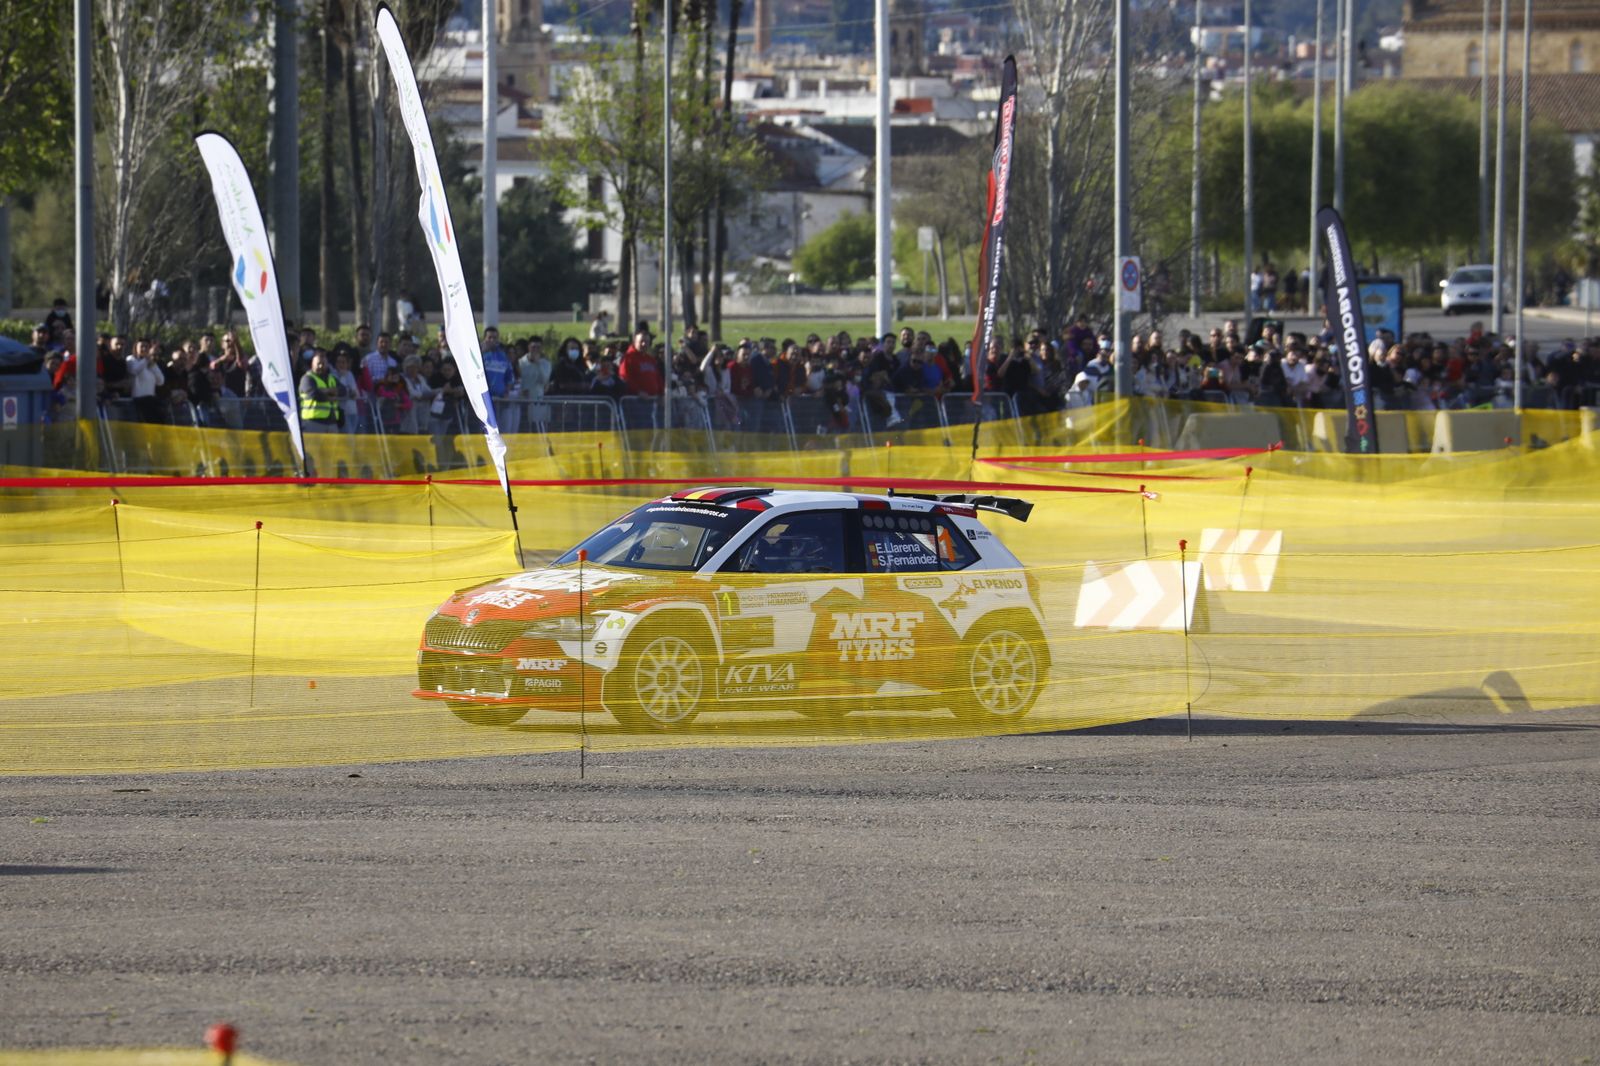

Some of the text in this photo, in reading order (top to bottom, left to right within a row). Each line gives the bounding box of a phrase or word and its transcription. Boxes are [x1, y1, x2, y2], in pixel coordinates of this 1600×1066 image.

[875, 542, 920, 554] E.Llarena
[879, 553, 938, 567] S.Fernández
[986, 578, 1022, 589] PENDO
[829, 612, 924, 640] MRF
[838, 639, 915, 662] TYRES
[516, 658, 567, 671] MRF
[533, 678, 561, 688] PAGID
[759, 683, 794, 693] WEAR
